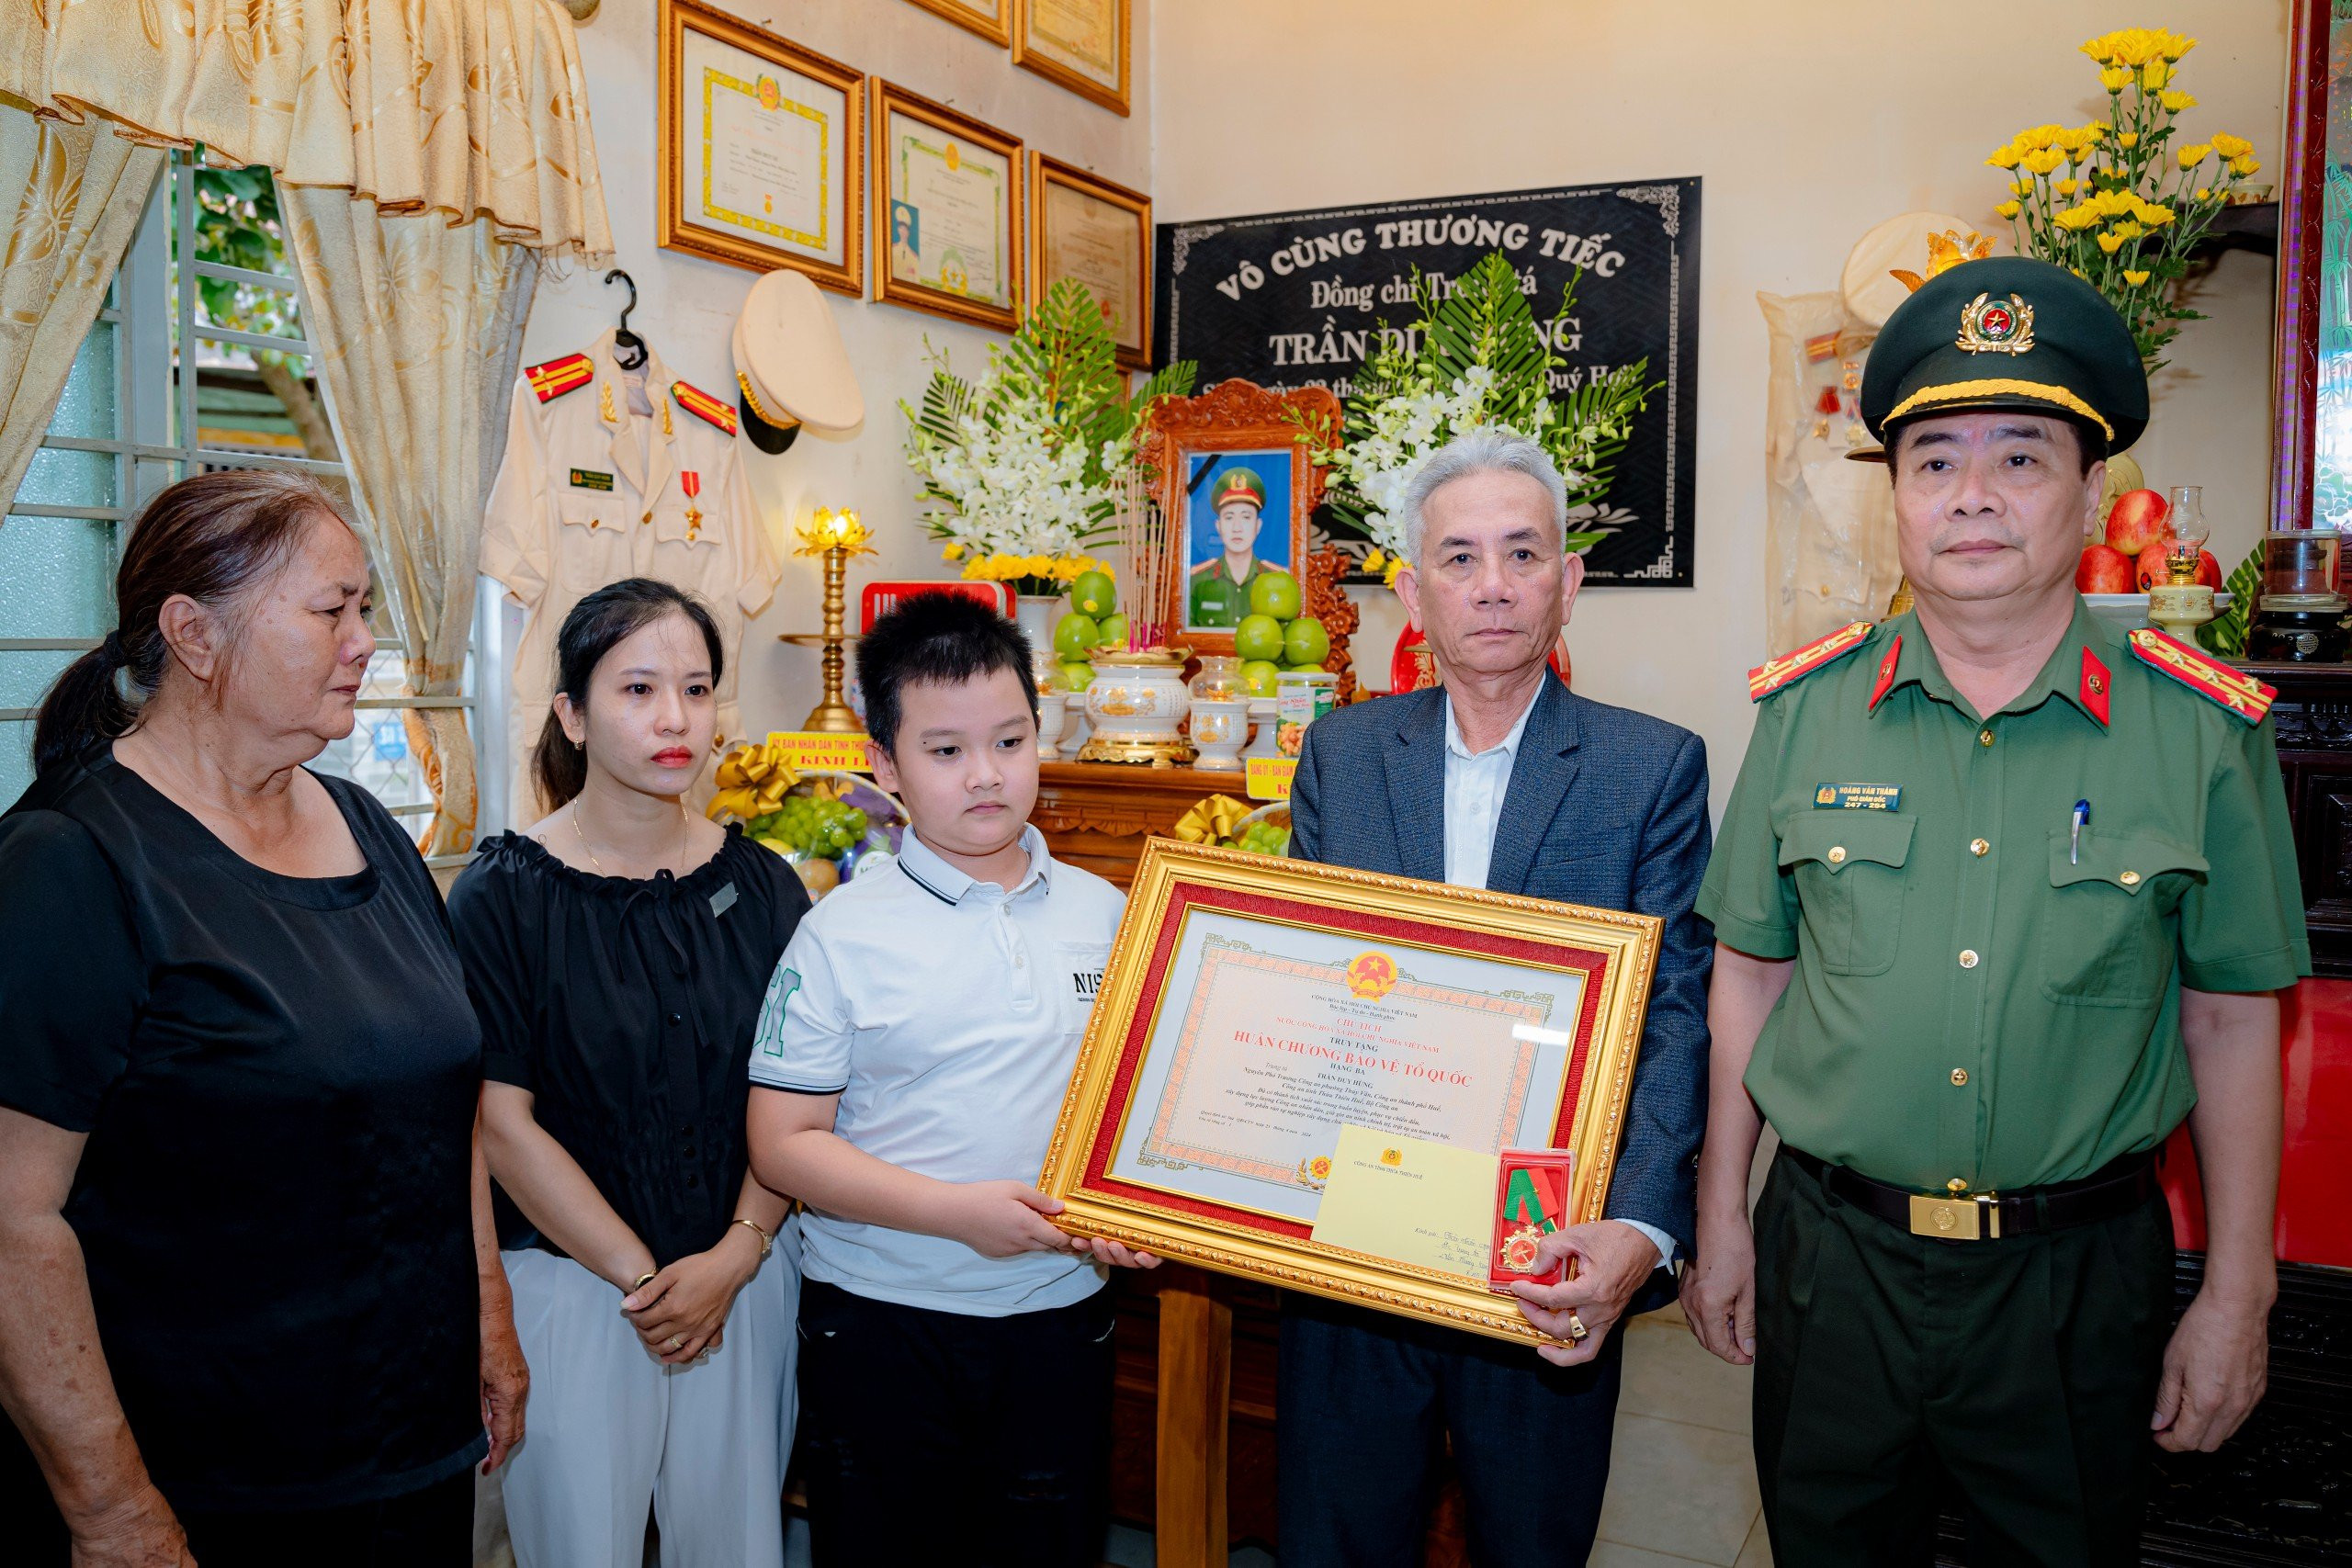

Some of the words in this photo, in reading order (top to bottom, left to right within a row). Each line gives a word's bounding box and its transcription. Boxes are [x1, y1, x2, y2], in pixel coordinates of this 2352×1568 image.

[1216, 260, 1265, 301] VÔ
[1271, 228, 1366, 276] CÙNG
[1374, 213, 1530, 250] THƯƠNG
[1539, 228, 1626, 277] TIẾC
[1310, 275, 1375, 311] Đồng
[1269, 315, 1369, 366] TRẦN
[1329, 1037, 1351, 1046] TRUY
[1354, 1042, 1378, 1052] TẶNG
[1422, 1044, 1440, 1053] NAM
[1234, 1030, 1275, 1047] HUÂN
[1277, 1038, 1341, 1061] CHƯƠNG
[1344, 1049, 1377, 1067] BẢO
[1379, 1056, 1399, 1075] VỆ
[1403, 1059, 1425, 1077] TỔ
[1426, 1068, 1473, 1088] QUỐC
[1330, 1063, 1351, 1072] HẠNG
[1337, 1076, 1351, 1084] DUY
[1352, 1078, 1374, 1088] HÙNG
